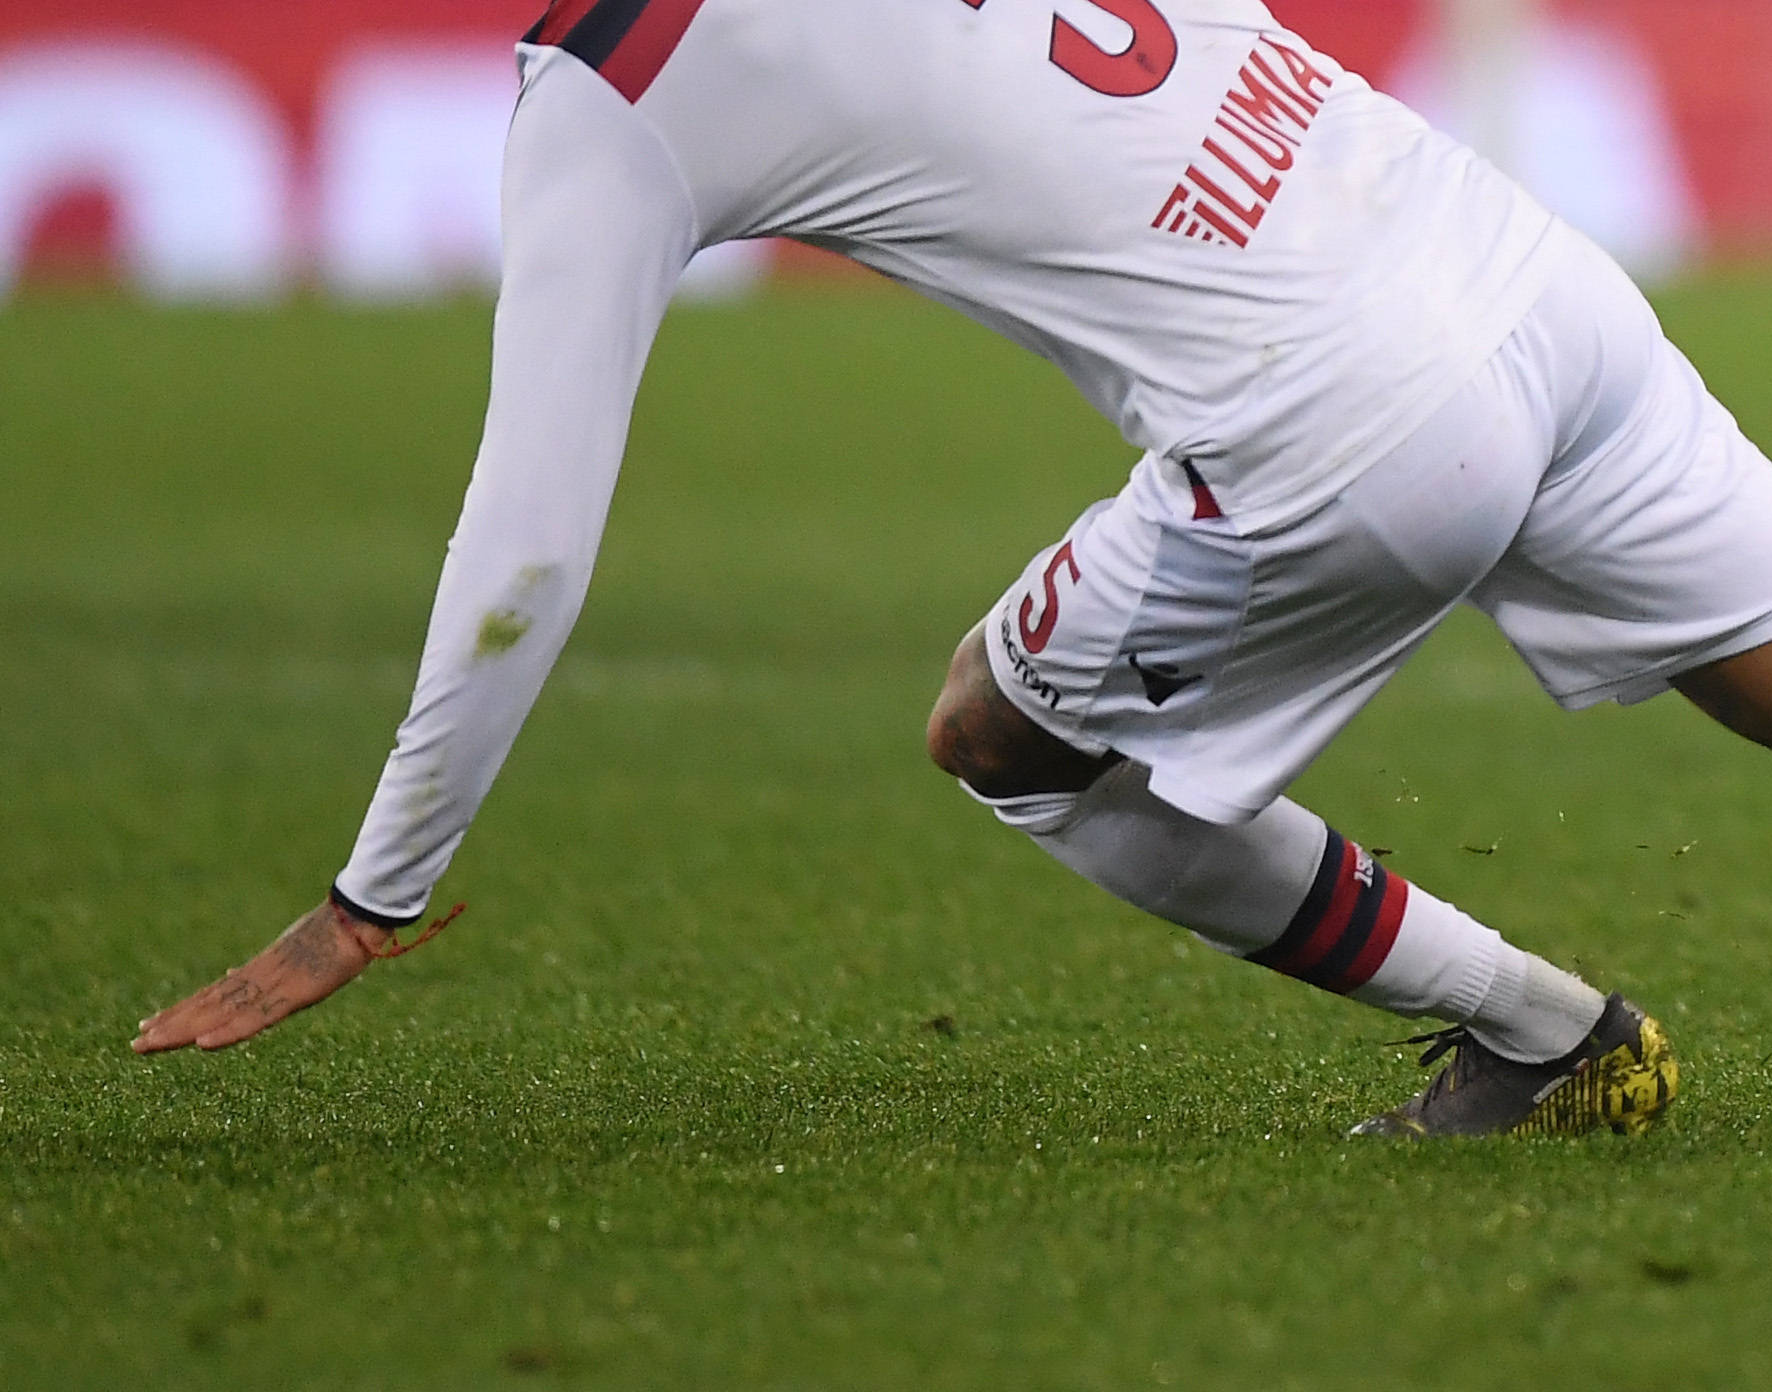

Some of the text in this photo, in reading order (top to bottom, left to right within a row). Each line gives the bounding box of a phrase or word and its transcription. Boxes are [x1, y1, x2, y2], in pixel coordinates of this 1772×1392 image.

[1180, 32, 1333, 250] ILLUMIA
[1018, 539, 1082, 655] 5
[1001, 604, 1061, 710] acron
